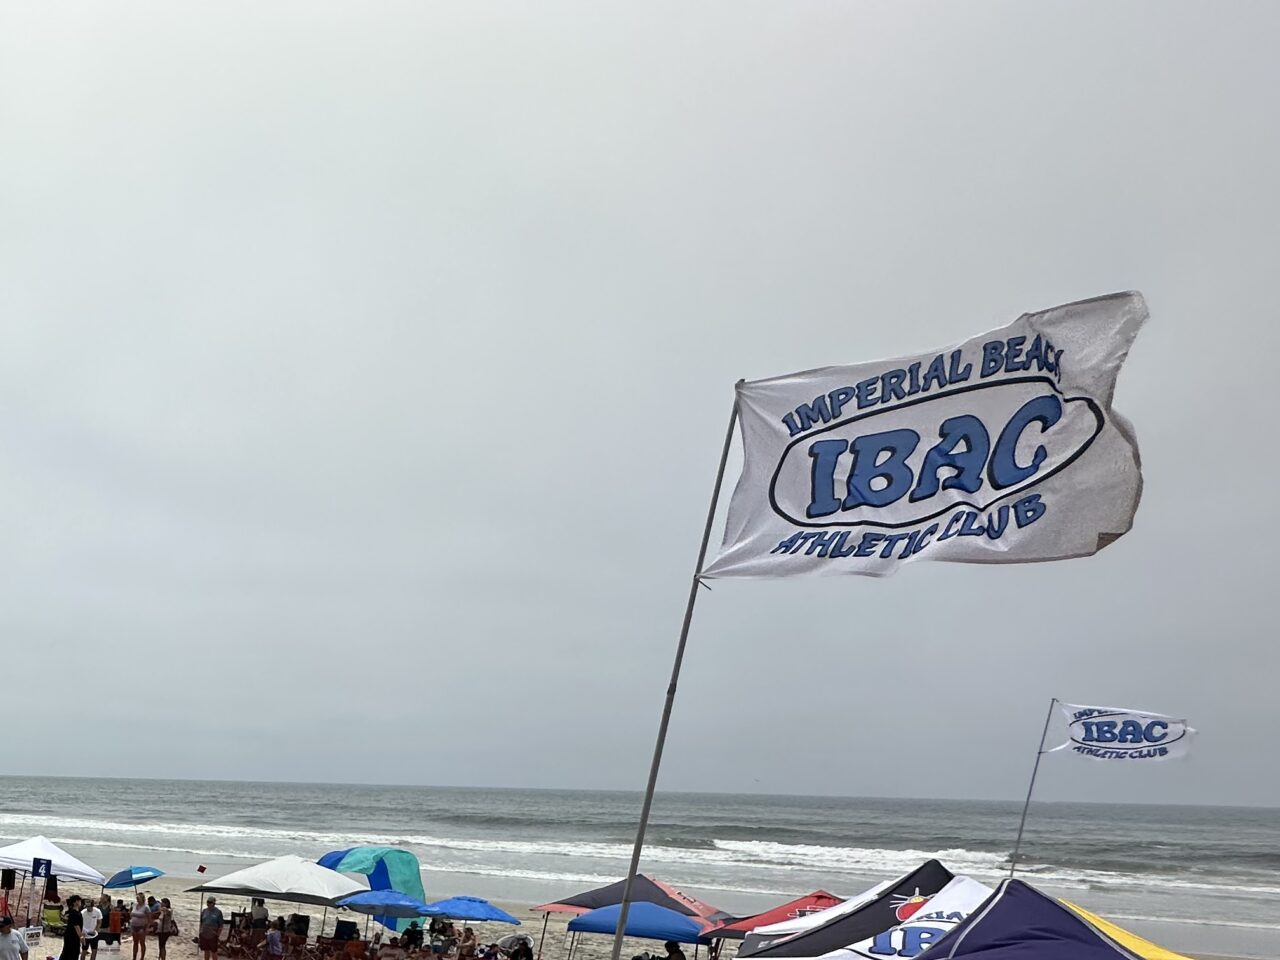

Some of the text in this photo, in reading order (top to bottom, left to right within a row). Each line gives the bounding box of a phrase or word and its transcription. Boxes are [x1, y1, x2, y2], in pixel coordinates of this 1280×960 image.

[781, 349, 972, 437] IMPERIAL
[806, 394, 1062, 519] IBAC
[770, 494, 1047, 560] ATHLETIC CLUB
[1081, 720, 1169, 744] IBAC
[1072, 745, 1169, 760] ATHLETIC CLUB
[38, 864, 46, 876] 4
[868, 926, 948, 957] IB
